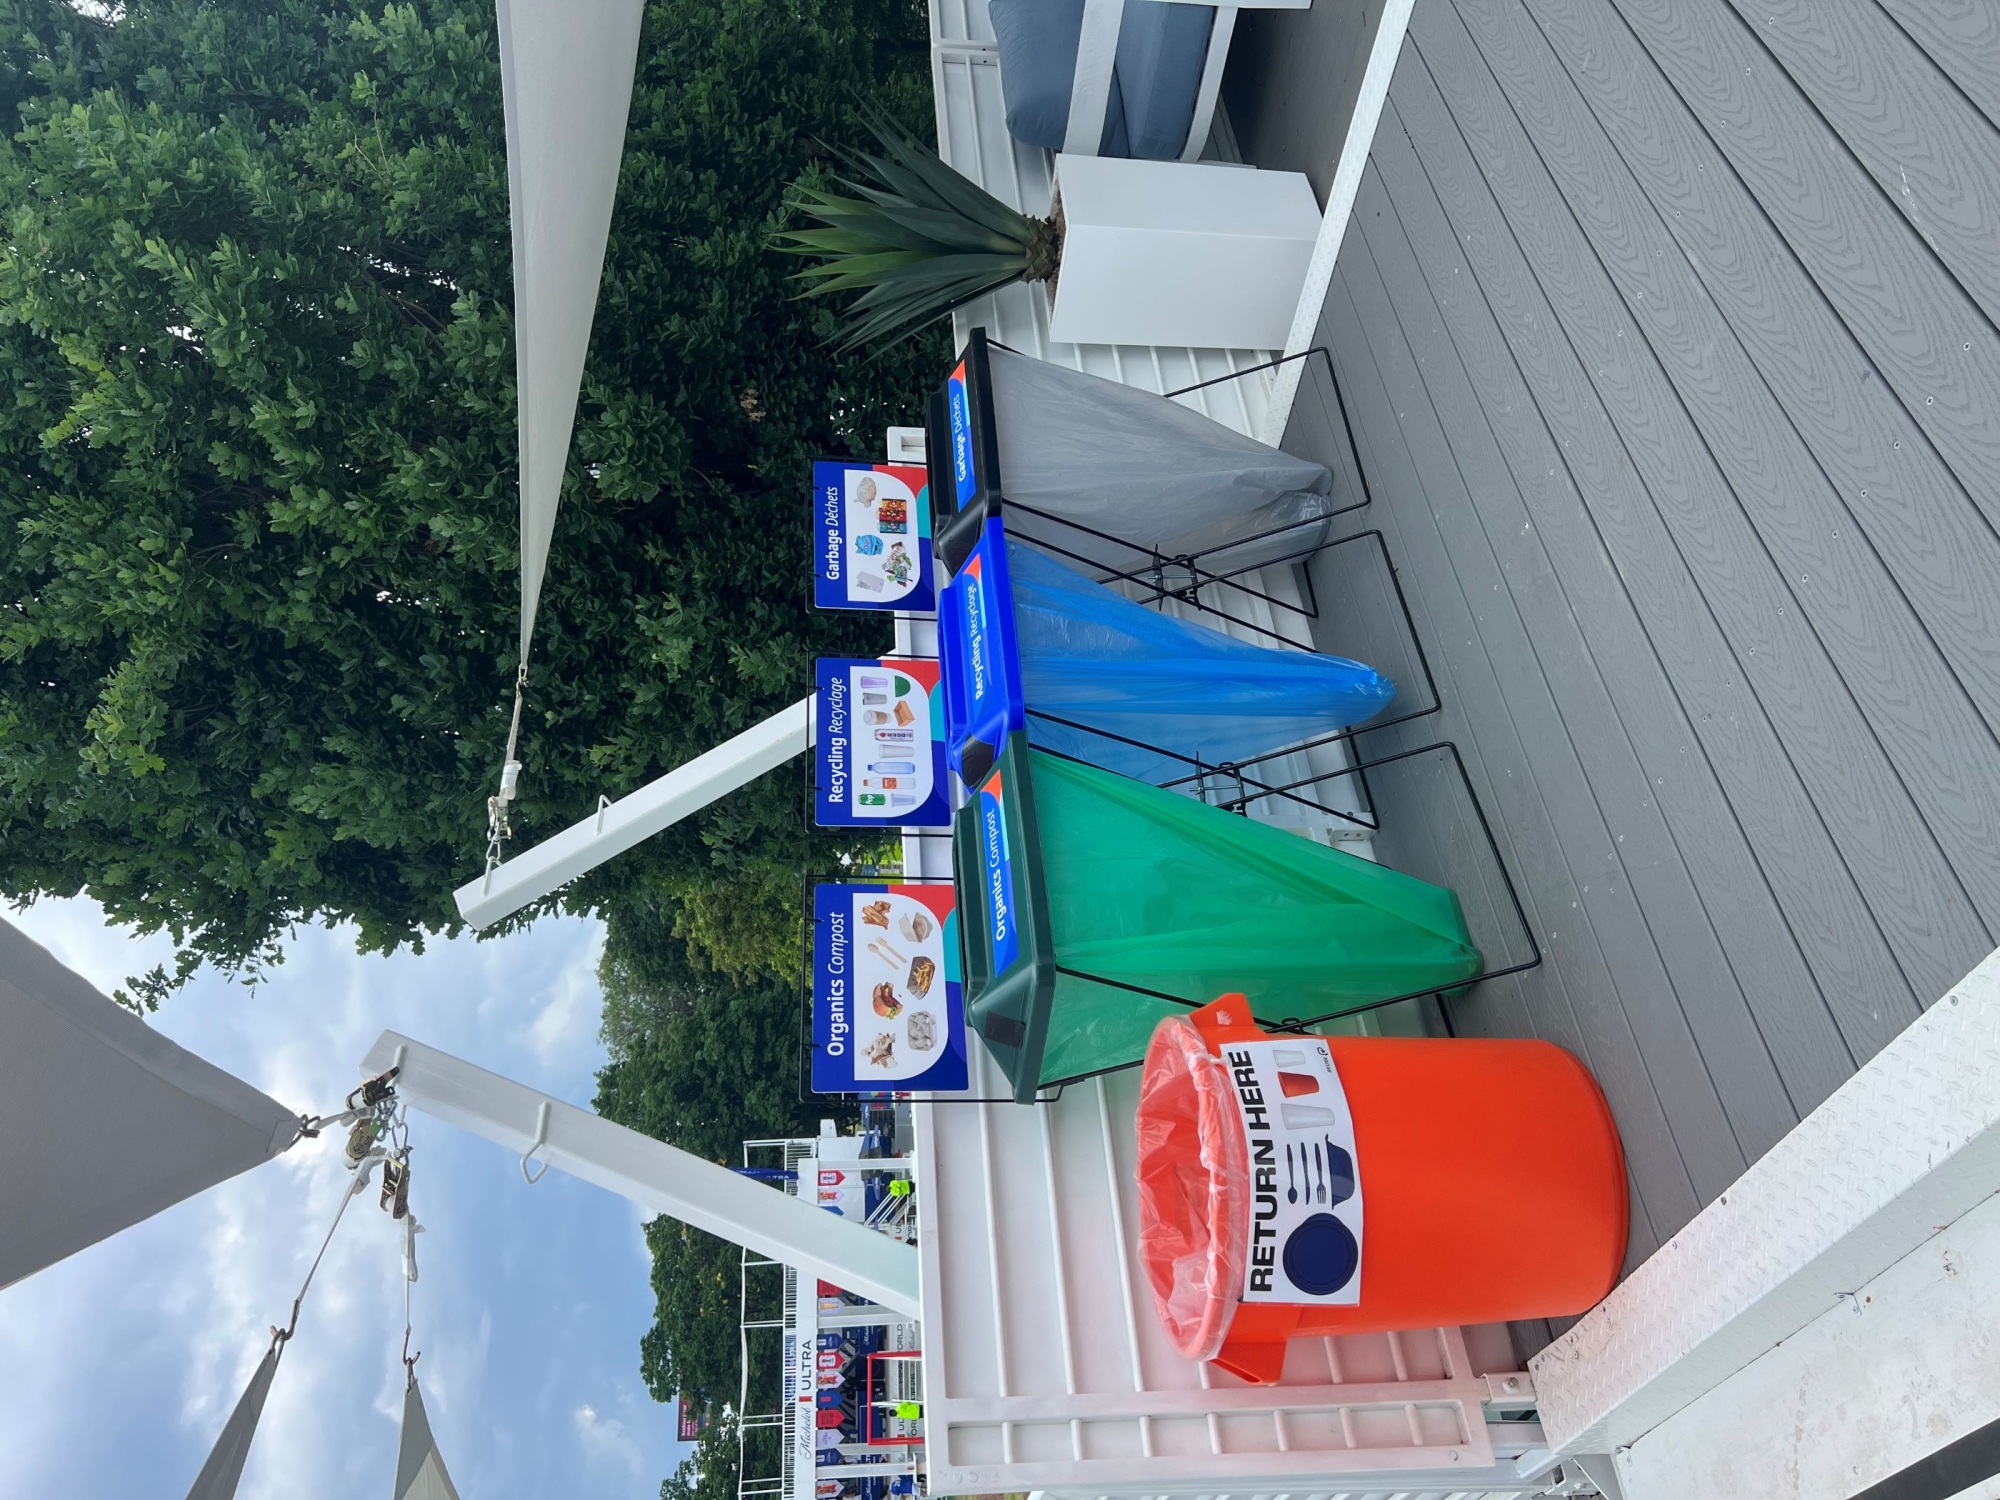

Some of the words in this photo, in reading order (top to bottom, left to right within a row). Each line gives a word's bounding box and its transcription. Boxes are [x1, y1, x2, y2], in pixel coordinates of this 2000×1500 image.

[953, 393, 963, 434] Déchets
[956, 431, 966, 482] Garbage
[824, 486, 839, 527] Déchets
[825, 529, 843, 580] Garbage
[967, 583, 979, 638] Recyclage
[972, 634, 984, 700] Recycling
[827, 677, 847, 734] Recyclage
[828, 737, 848, 803] Recycling
[986, 808, 1000, 868] Compost
[992, 868, 1007, 941] Organics
[827, 911, 849, 975] Compost
[826, 978, 849, 1057] Organics
[1228, 1050, 1271, 1130] HERE
[1324, 1057, 1333, 1073] REUSE
[1250, 1139, 1278, 1293] RETURN
[801, 1339, 812, 1391] ULTRA
[895, 1323, 904, 1351] ORLD
